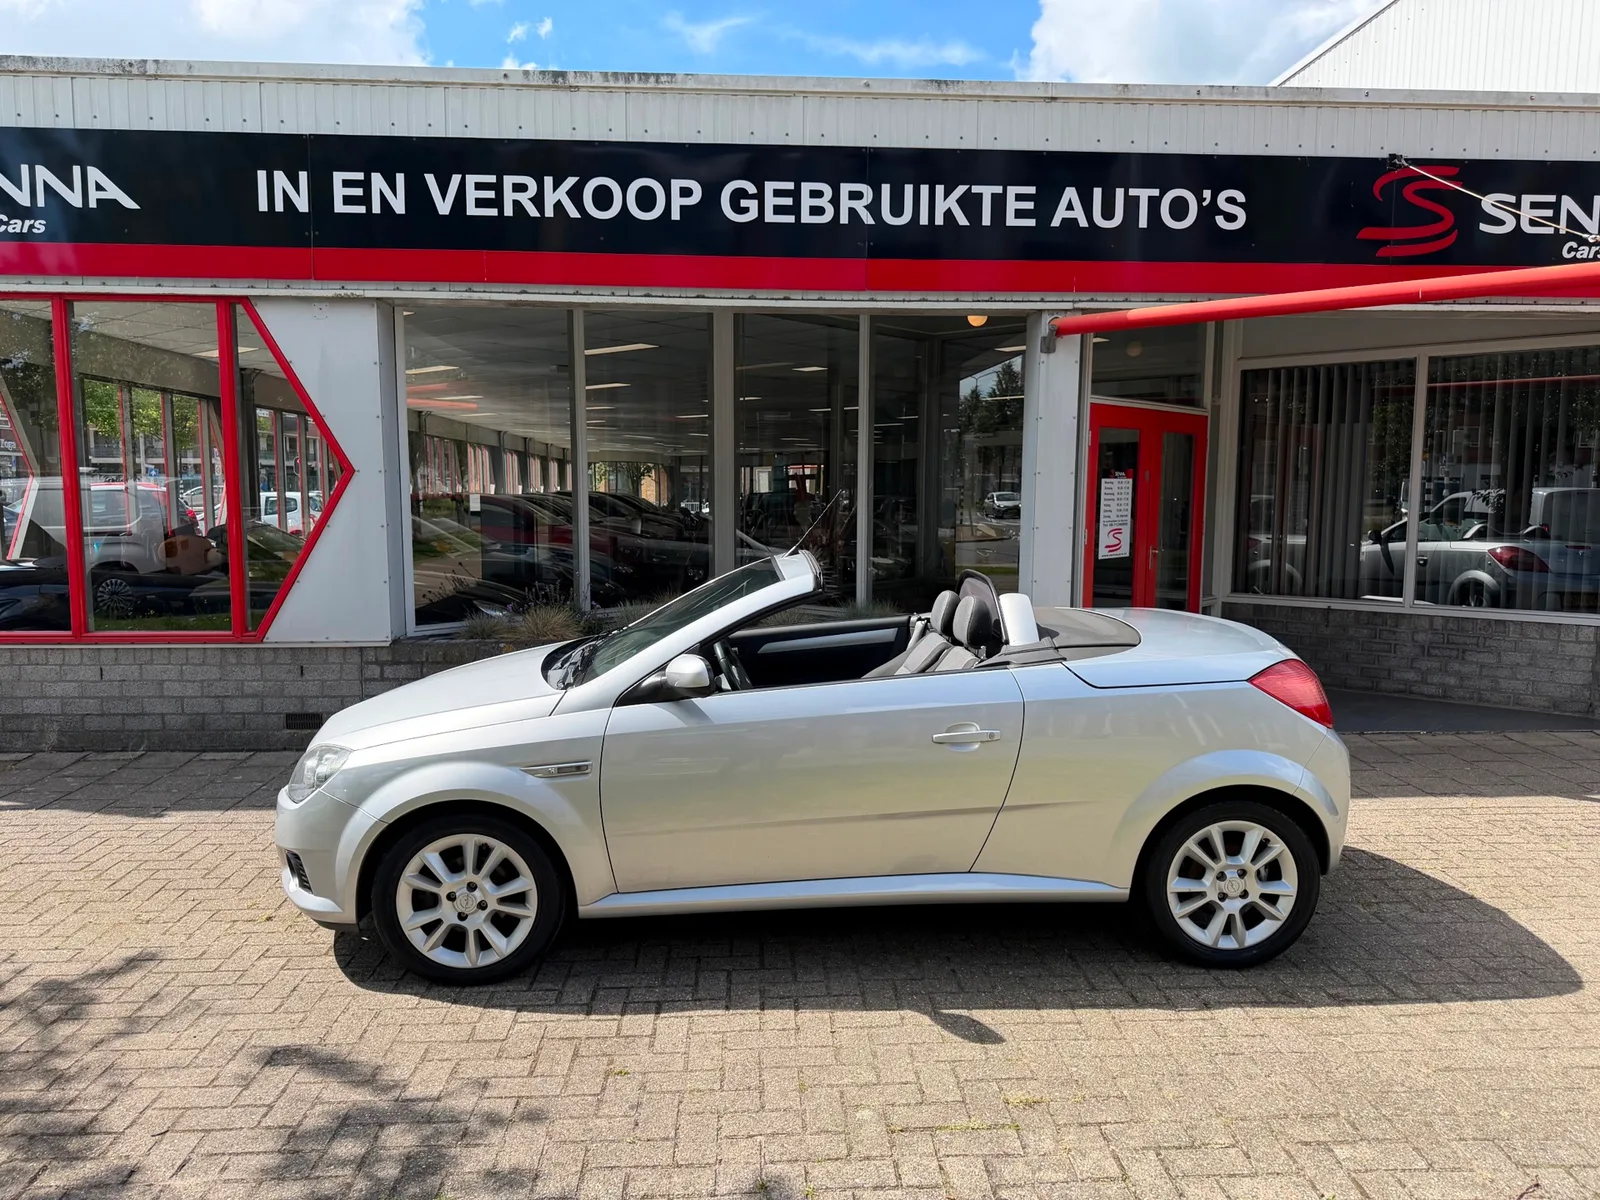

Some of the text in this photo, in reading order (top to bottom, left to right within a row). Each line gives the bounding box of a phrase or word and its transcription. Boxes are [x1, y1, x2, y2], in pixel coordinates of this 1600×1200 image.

[256, 169, 309, 213] IN
[332, 171, 406, 215] EN
[423, 173, 703, 221] VERKOOP
[720, 179, 1037, 227] GEBRUIKTE
